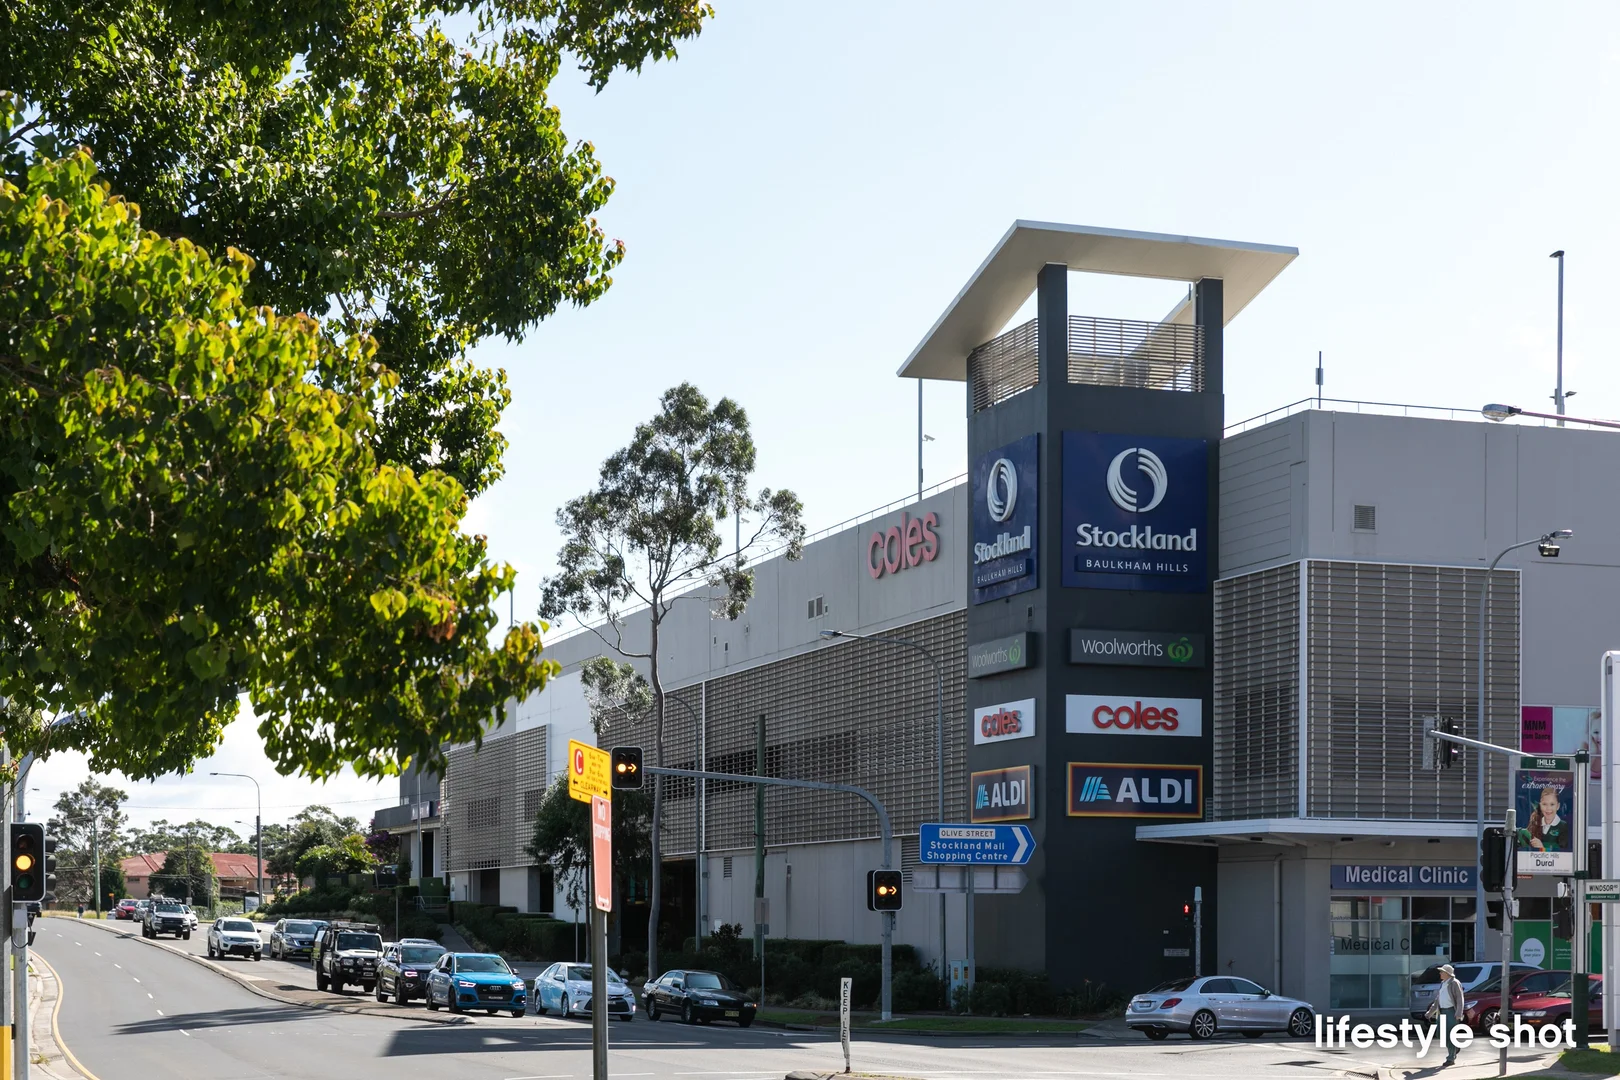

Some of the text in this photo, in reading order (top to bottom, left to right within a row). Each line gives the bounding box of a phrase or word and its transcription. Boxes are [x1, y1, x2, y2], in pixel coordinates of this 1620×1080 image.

[868, 512, 940, 579] coles
[974, 526, 1031, 564] Stockland
[1076, 523, 1197, 551] Stockland
[977, 564, 1023, 584] BAULKHAM HILLS
[1086, 559, 1189, 572] BAULKHAM HILLS
[972, 647, 1008, 668] Woolworths
[1081, 638, 1163, 657] Woolworths
[981, 708, 1021, 737] coles
[1092, 701, 1179, 731] coles
[1524, 720, 1546, 731] MNM
[575, 750, 583, 774] C
[991, 780, 1026, 808] ALDI
[1115, 777, 1192, 804] ALDI
[930, 841, 1005, 850] Stockland Mall
[926, 851, 1008, 862] Shopping Centre
[1535, 859, 1555, 867] Dural
[1345, 866, 1468, 884] Medical Clinic
[1589, 884, 1613, 892] WINDSOR
[1341, 938, 1394, 951] Medical
